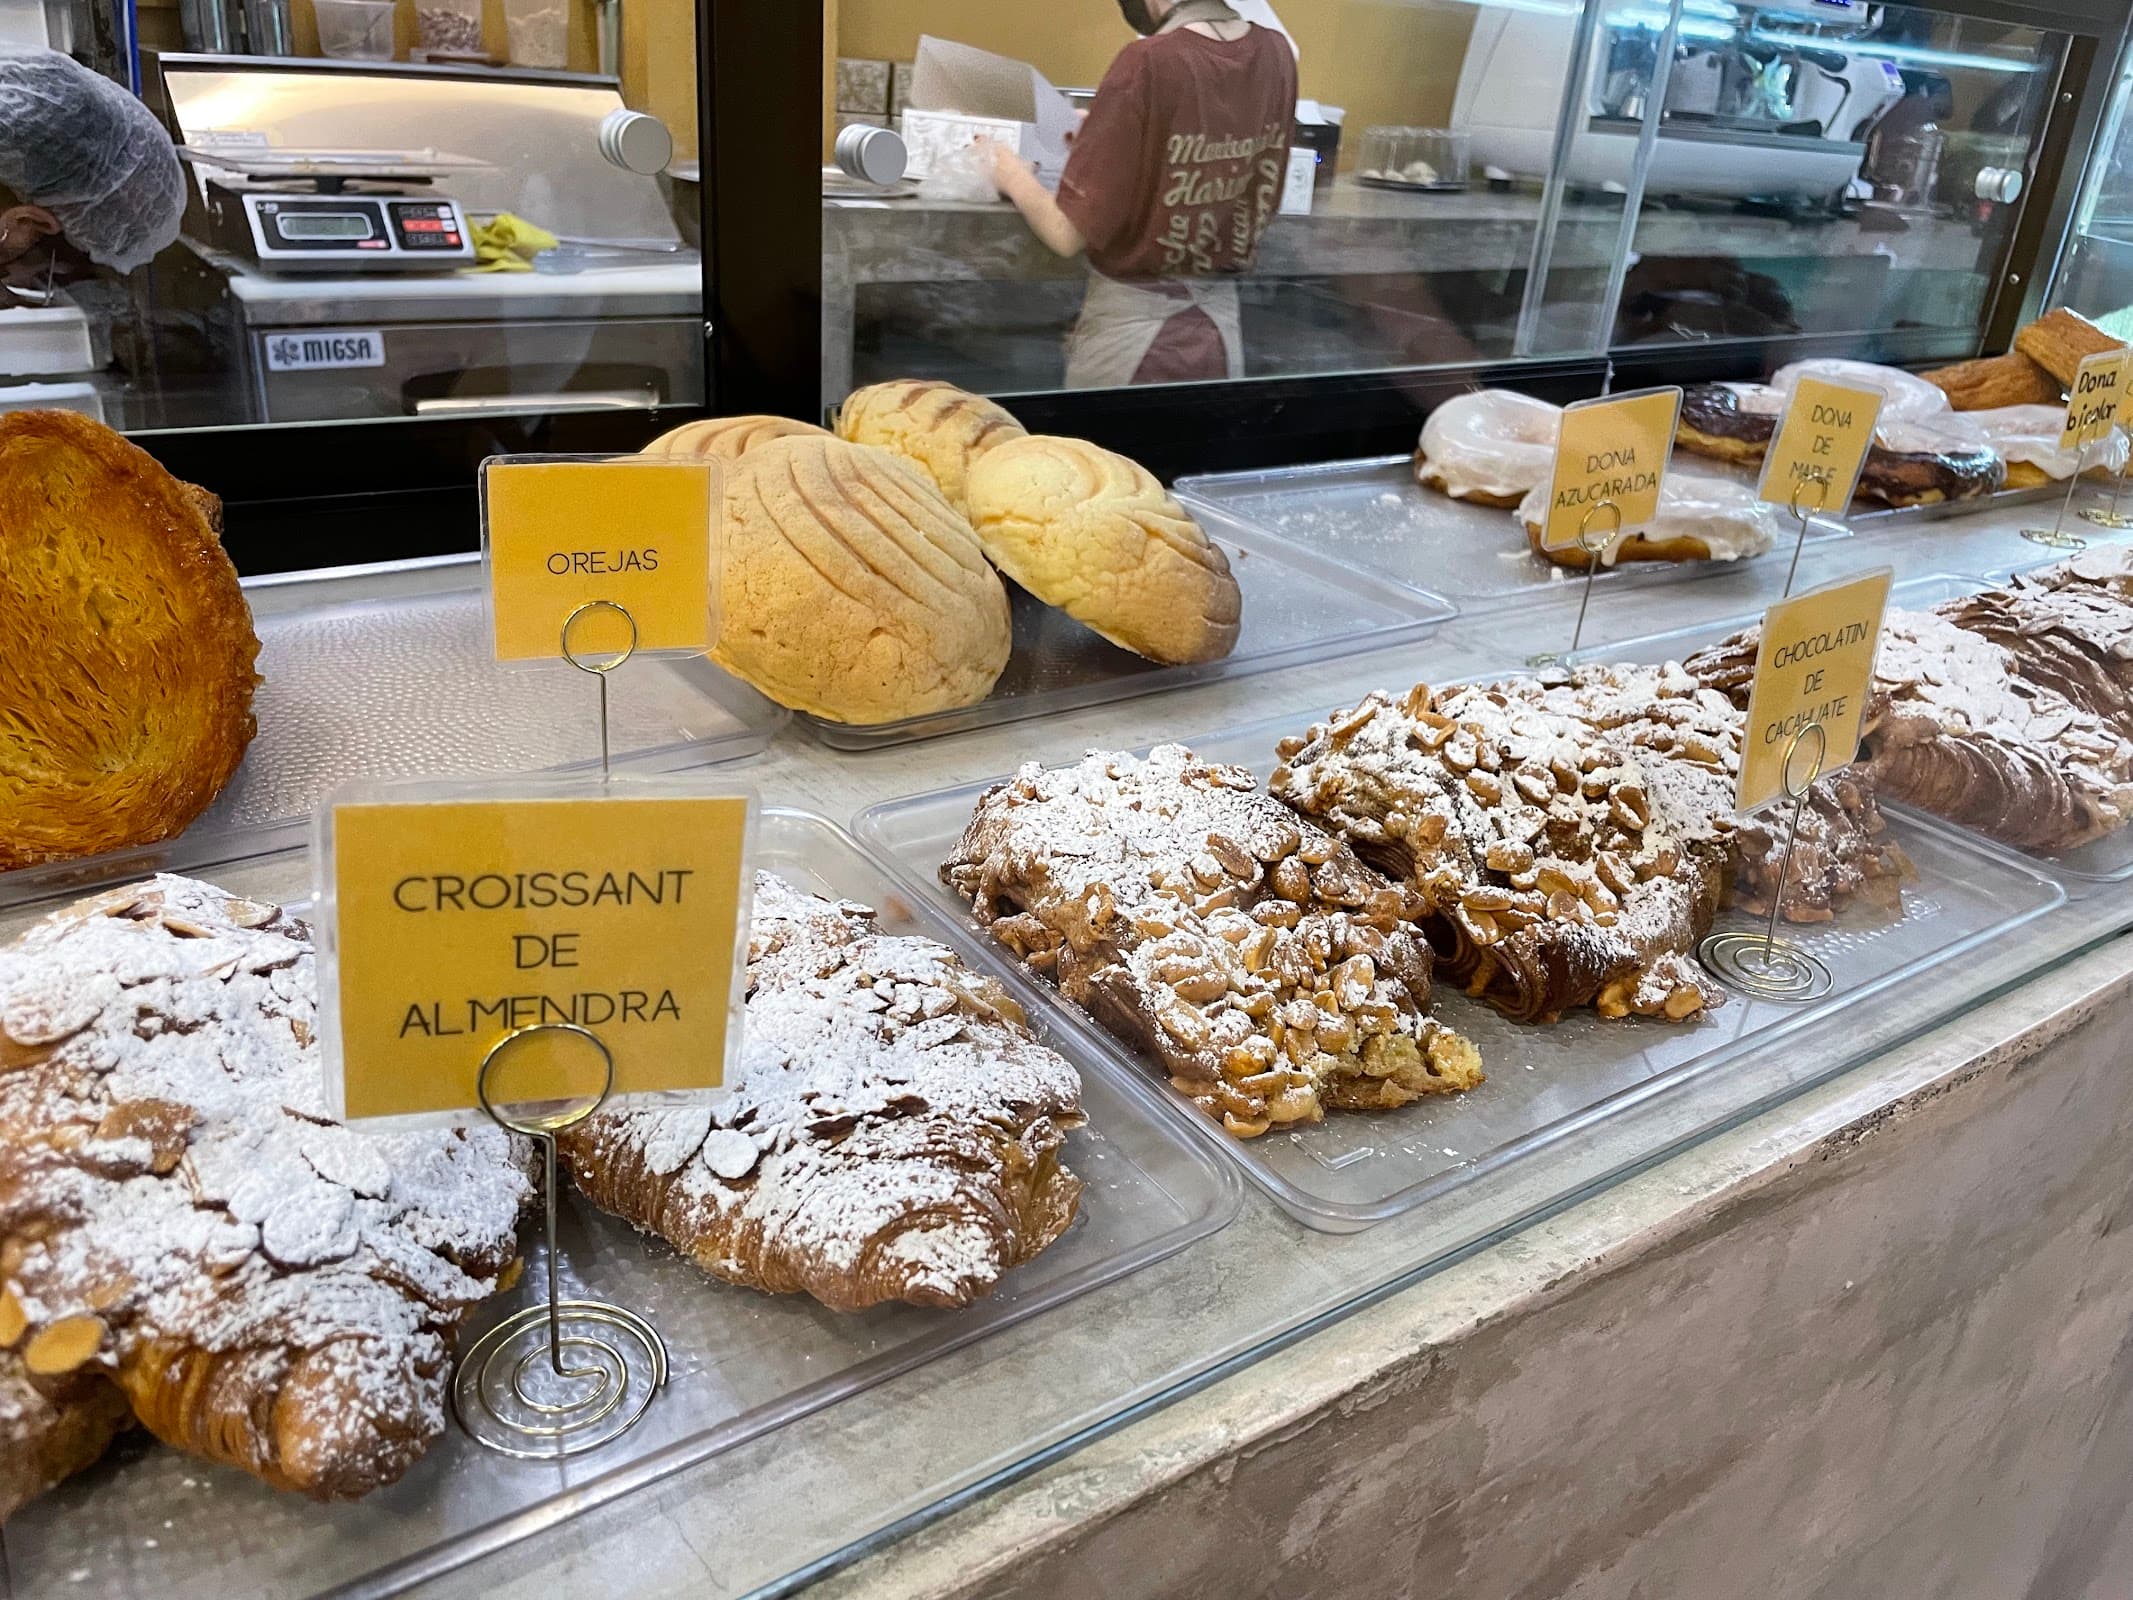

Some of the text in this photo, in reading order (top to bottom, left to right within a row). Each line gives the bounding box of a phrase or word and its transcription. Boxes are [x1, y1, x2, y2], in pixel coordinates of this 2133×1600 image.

[303, 338, 372, 362] MIGSA
[2078, 370, 2117, 394] Dona
[1811, 404, 1853, 428] DONA
[1812, 434, 1834, 456] DE
[1586, 447, 1636, 474] DONA
[1554, 471, 1657, 510] AZUCARADA
[547, 548, 659, 575] OREJAS
[1774, 620, 1869, 669] CHOCOLATIN
[1803, 669, 1825, 695] DE
[393, 870, 694, 912] CROISSANT
[512, 933, 581, 969] DE
[399, 989, 681, 1039] ALMENDRA
